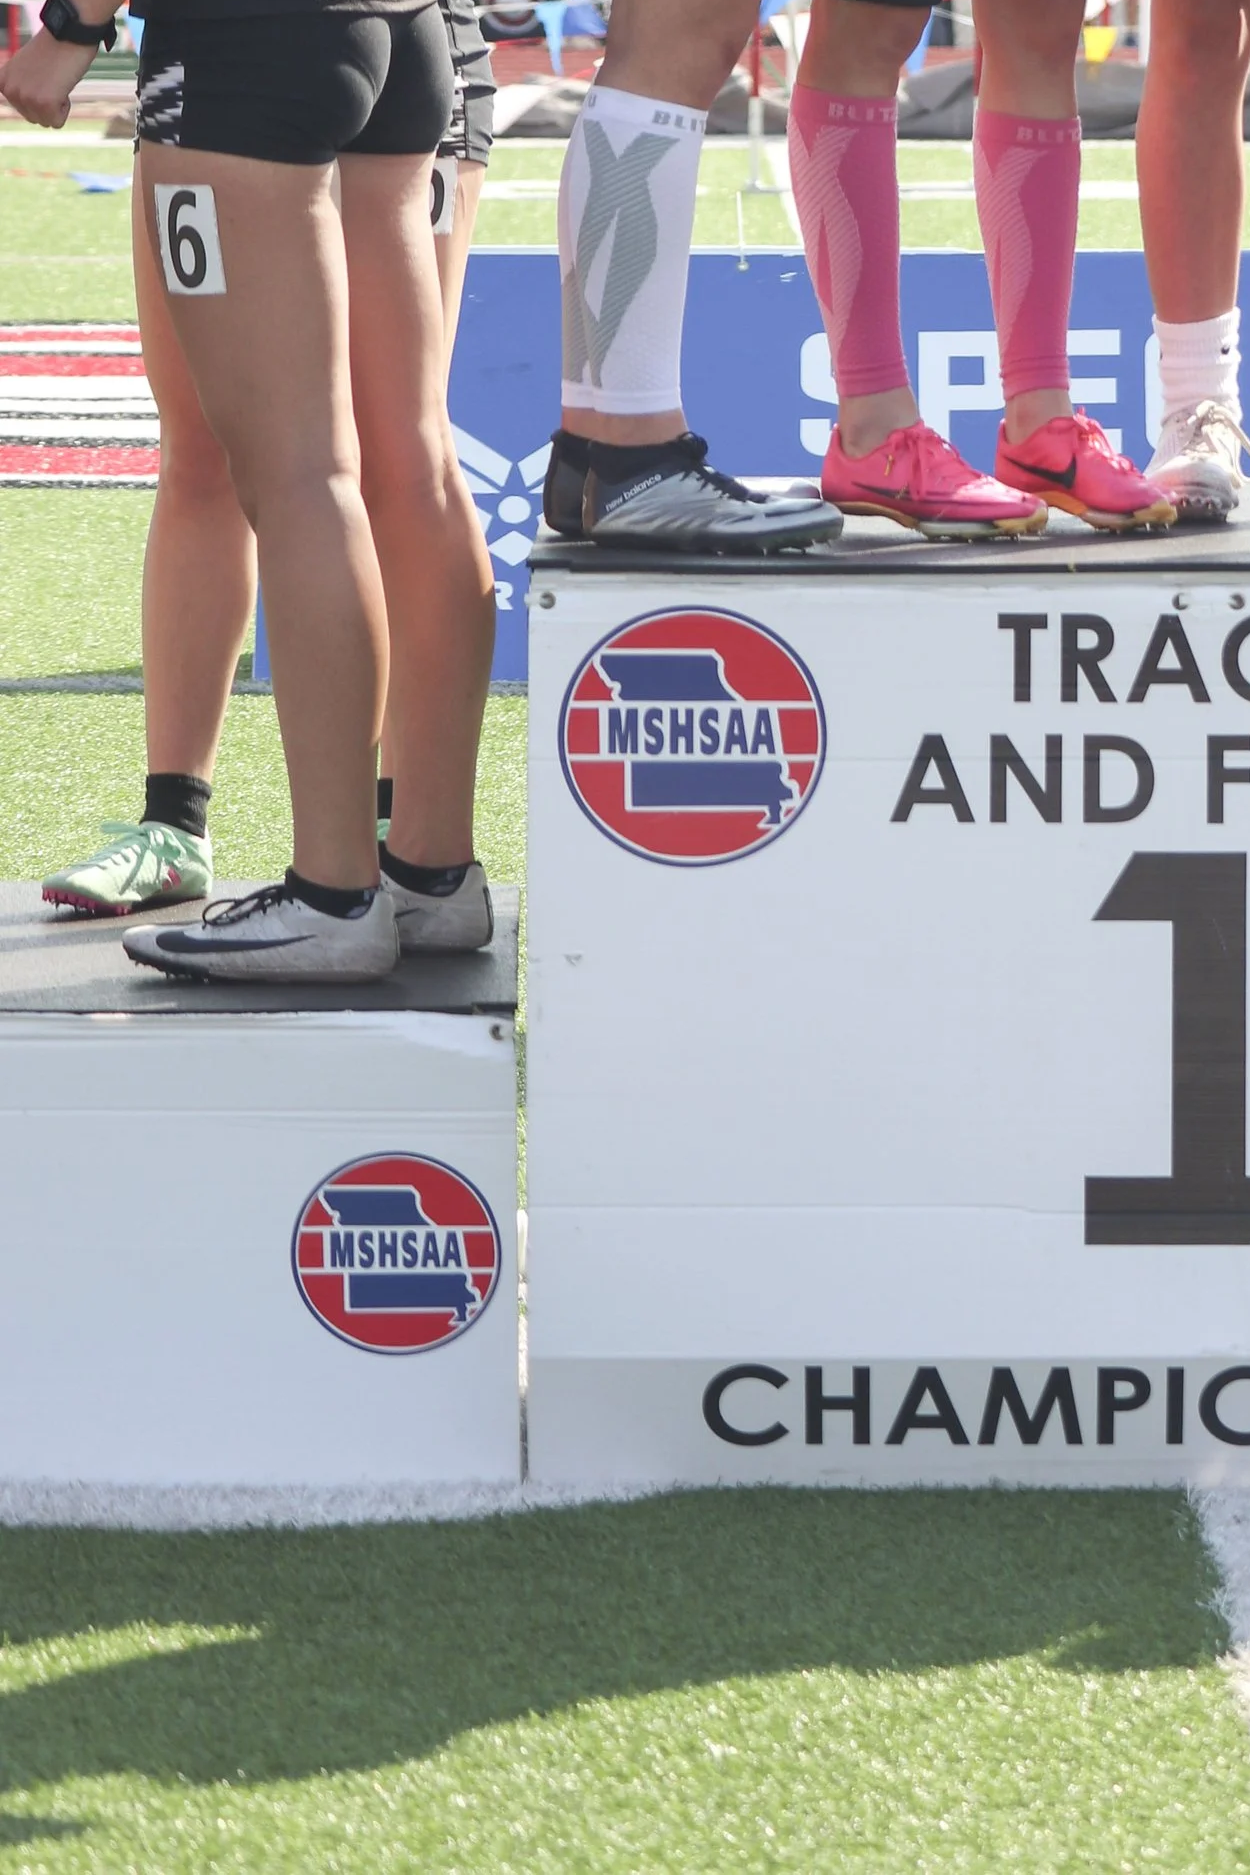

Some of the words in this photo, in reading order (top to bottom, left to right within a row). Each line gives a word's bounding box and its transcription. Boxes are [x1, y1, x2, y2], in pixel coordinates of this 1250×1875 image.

[168, 190, 207, 288] 6
[605, 496, 624, 513] new
[622, 473, 663, 501] balance
[607, 707, 778, 756] MSHSAA
[891, 734, 1155, 824] AND
[328, 1230, 463, 1269] MSHSAA
